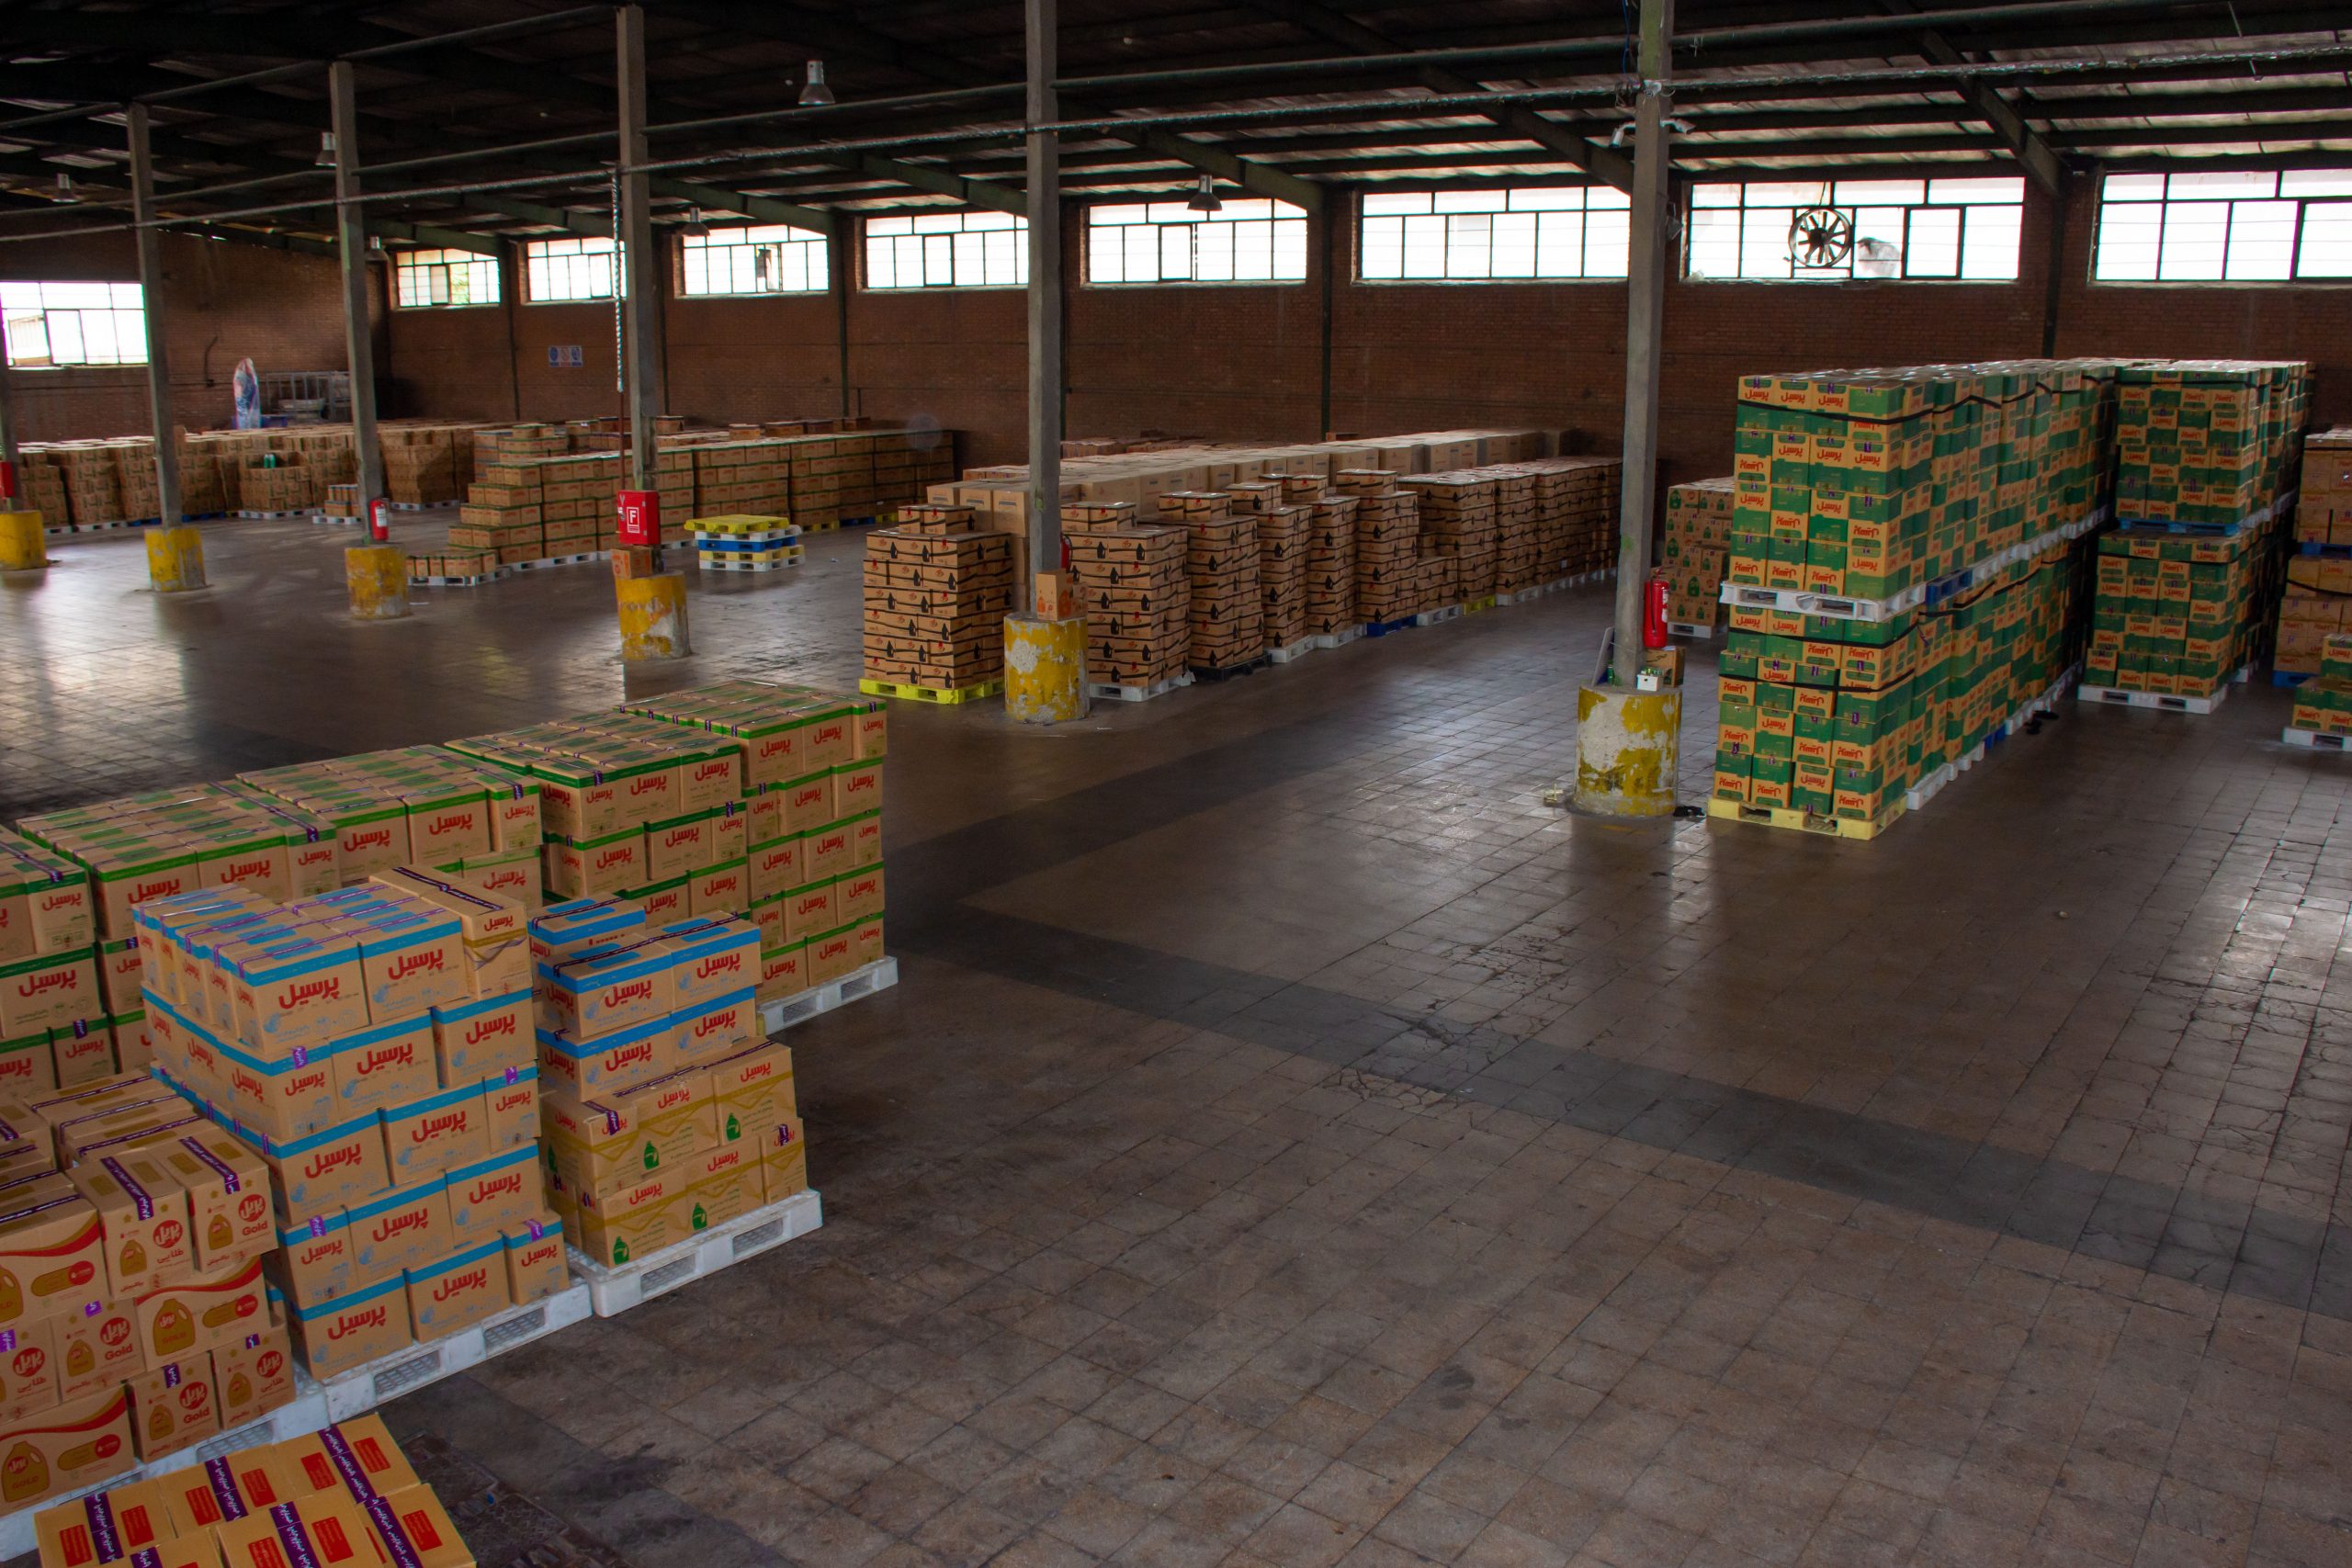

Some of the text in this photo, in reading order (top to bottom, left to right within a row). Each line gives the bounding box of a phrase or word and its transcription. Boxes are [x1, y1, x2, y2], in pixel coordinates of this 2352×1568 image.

[629, 510, 636, 524] F
[814, 726, 842, 744] پرسیل
[761, 739, 790, 758] پرسیل
[695, 761, 729, 781] پرسیل
[630, 776, 667, 795] پرسیل
[847, 775, 875, 792] پرسیل
[586, 787, 613, 804] پرسیل
[796, 788, 821, 807] پرسیل
[505, 805, 535, 819] پرسیل
[429, 814, 472, 834] پرسیل
[720, 819, 742, 831] پرسیل
[344, 829, 390, 852] پرسیل
[665, 829, 698, 847] پرسیل
[818, 836, 843, 854] پرسیل
[298, 849, 331, 865] پرسیل
[597, 847, 632, 869] پرسیل
[763, 851, 792, 871] پرسیل
[221, 860, 270, 884] پرسیل
[483, 871, 526, 890] پرسیل
[129, 879, 180, 904] پرسیل
[706, 876, 736, 897] پرسیل
[849, 880, 875, 897] پرسیل
[42, 893, 81, 911] پرسیل
[645, 893, 676, 914] پرسیل
[798, 896, 827, 915] پرسیل
[485, 916, 513, 931] پرسیل
[820, 941, 847, 959] پرسیل
[118, 957, 141, 974] سیل
[388, 949, 443, 979] پرسیل
[696, 953, 741, 978] پرسیل
[764, 960, 796, 980] پرسیل
[18, 970, 76, 997] پرسیل
[279, 977, 338, 1009] پرسیل
[605, 981, 651, 1008] پرسیل
[467, 1014, 514, 1044] پرسیل
[695, 1010, 735, 1037] پرسیل
[66, 1040, 103, 1058] پرسیل
[357, 1043, 413, 1075] پرسیل
[605, 1043, 651, 1071] پرسیل
[741, 1062, 771, 1082] پرسیل
[285, 1072, 324, 1096] پرسیل
[496, 1091, 531, 1111] پرسیل
[412, 1110, 466, 1143] پرسیل
[602, 1117, 628, 1134] پرل
[305, 1143, 361, 1179] پرسیل
[707, 1151, 739, 1172] پرسیل
[469, 1173, 521, 1203] پرسیل
[629, 1183, 662, 1205] پرسیل
[243, 1222, 267, 1235] Gold
[373, 1209, 428, 1242] پرسیل
[301, 1240, 342, 1264] پرسیل
[521, 1245, 557, 1267] پرسیل
[434, 1268, 486, 1302] پرسیل
[327, 1306, 385, 1339] پرسیل
[105, 1344, 132, 1359] Gold
[184, 1407, 209, 1423] Gold
